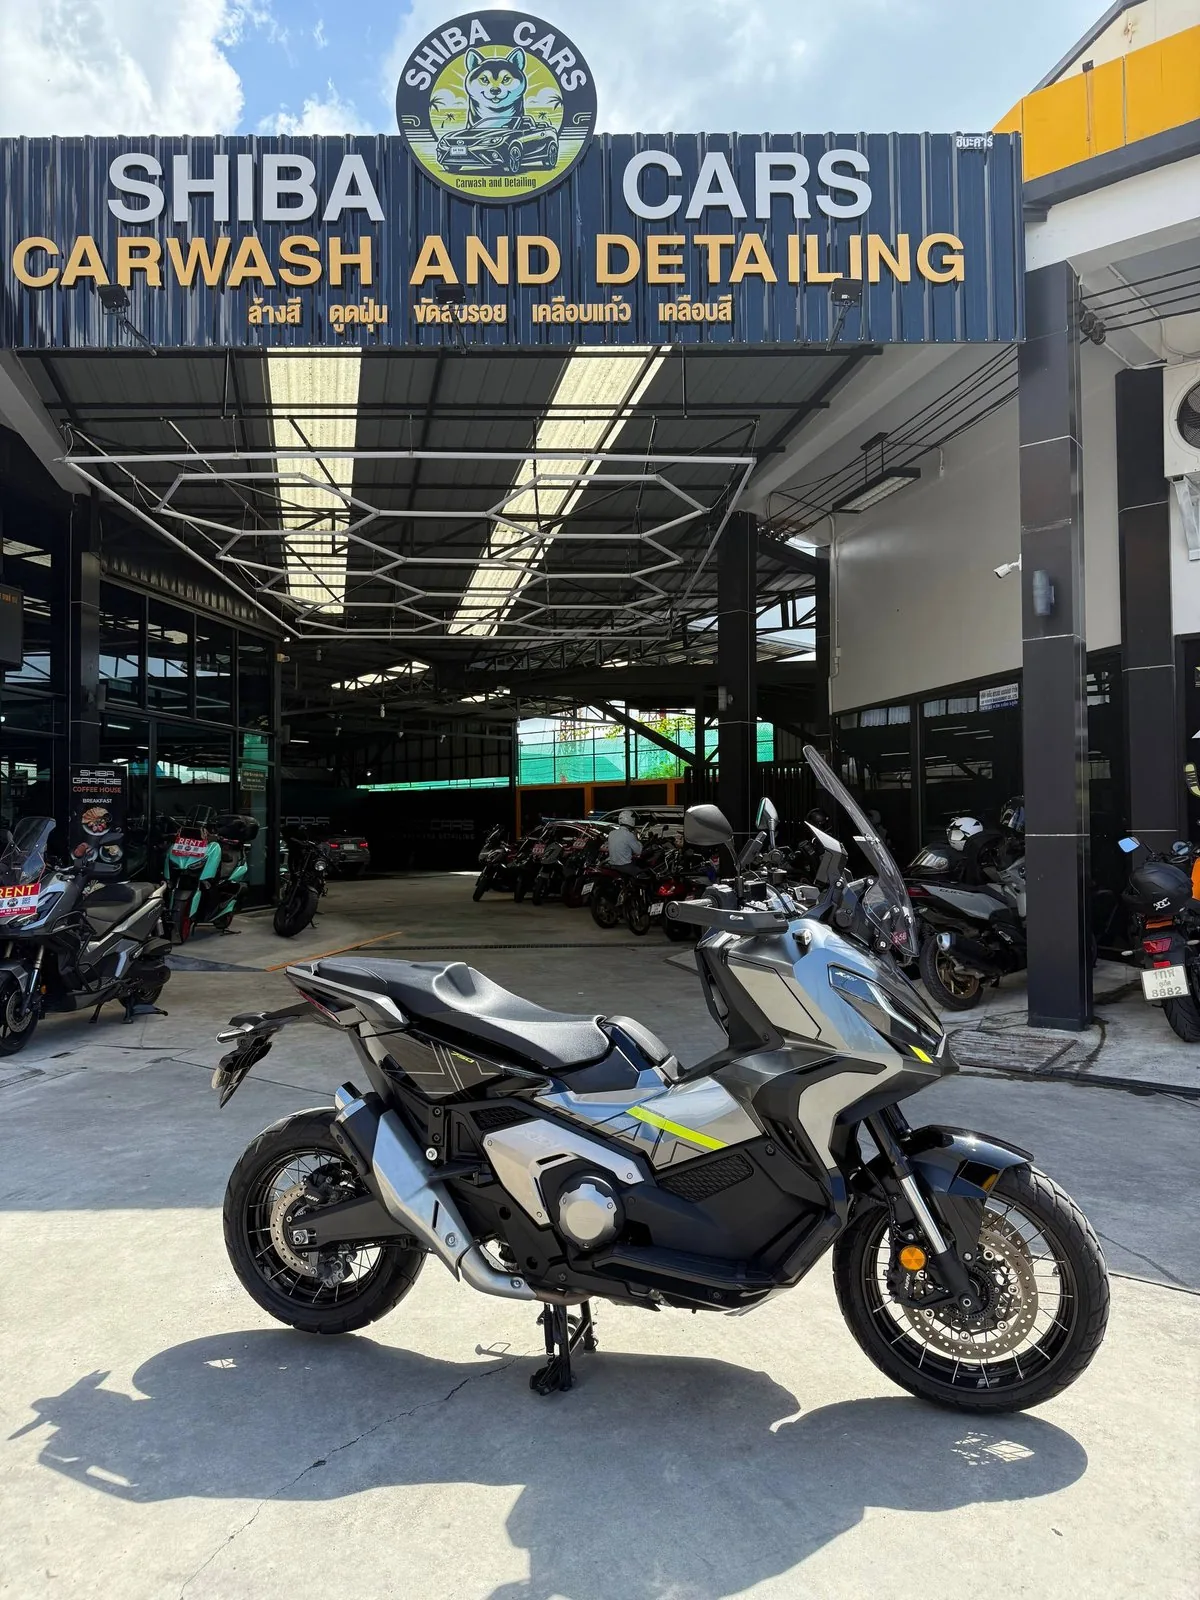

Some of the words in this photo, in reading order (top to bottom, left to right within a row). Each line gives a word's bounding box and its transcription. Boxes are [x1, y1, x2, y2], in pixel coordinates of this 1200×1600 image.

[405, 19, 491, 91] SHIBA
[513, 21, 587, 92] CARS
[108, 152, 385, 223] SHIBA
[622, 149, 872, 220] CARS
[455, 178, 486, 188] Carwash
[489, 178, 502, 187] and
[504, 177, 536, 188] Detailing
[12, 235, 373, 287] CARWASH
[409, 235, 561, 285] AND
[596, 233, 965, 285] DETAILING
[248, 297, 301, 323] ล้างสี
[329, 296, 388, 332] ดูดฝุ่น
[532, 295, 632, 322] เคลือบแก้ว
[658, 294, 732, 321] เคลือบสี
[80, 769, 115, 777] SHIBA
[72, 777, 121, 785] GARAGE
[178, 837, 202, 846] RENT
[1151, 986, 1182, 998] 8882
